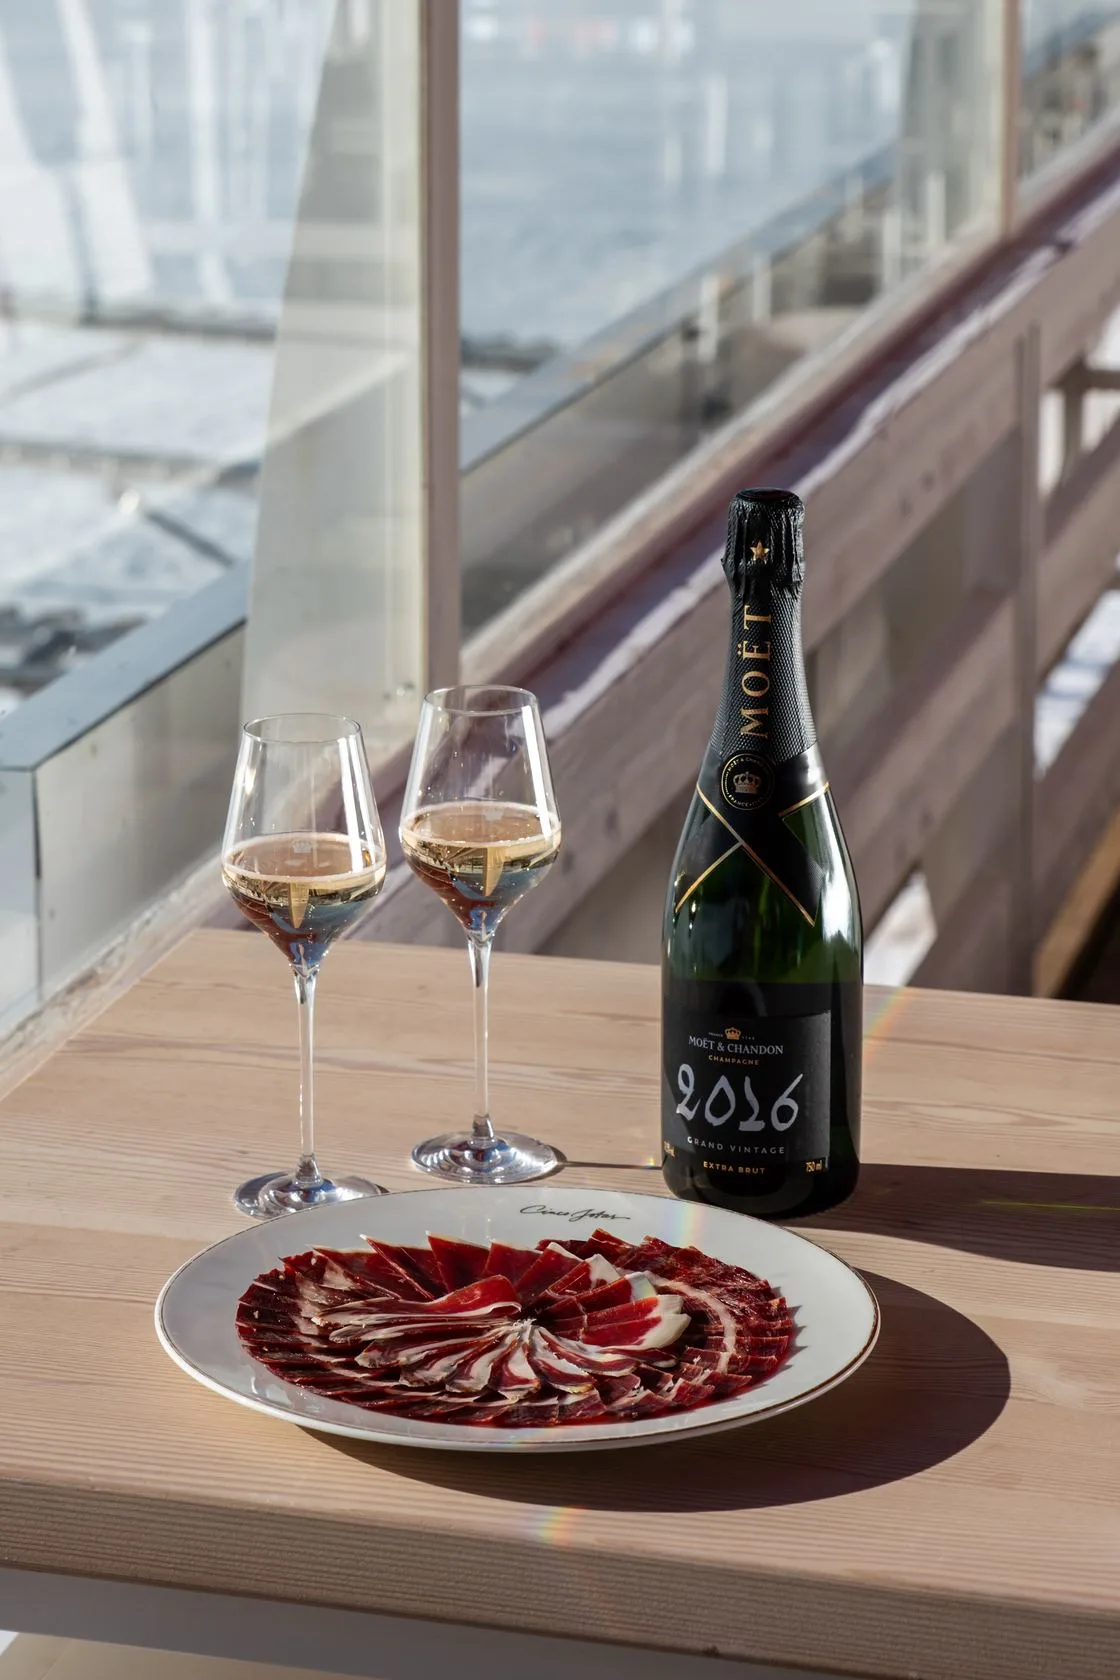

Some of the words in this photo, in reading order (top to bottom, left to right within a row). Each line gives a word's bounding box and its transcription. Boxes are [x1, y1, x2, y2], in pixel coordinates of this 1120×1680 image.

[735, 604, 773, 740] MOËT
[688, 1035, 714, 1050] MOËT
[717, 1042, 726, 1052] &
[727, 1043, 784, 1055] CHANDON
[708, 1054, 760, 1066] CHAMPAGNE
[675, 1063, 804, 1132] 2016
[687, 1136, 724, 1151] GRAND
[730, 1144, 786, 1154] VINTAGE
[703, 1160, 734, 1173] EXTRA
[738, 1164, 766, 1175] BRUT
